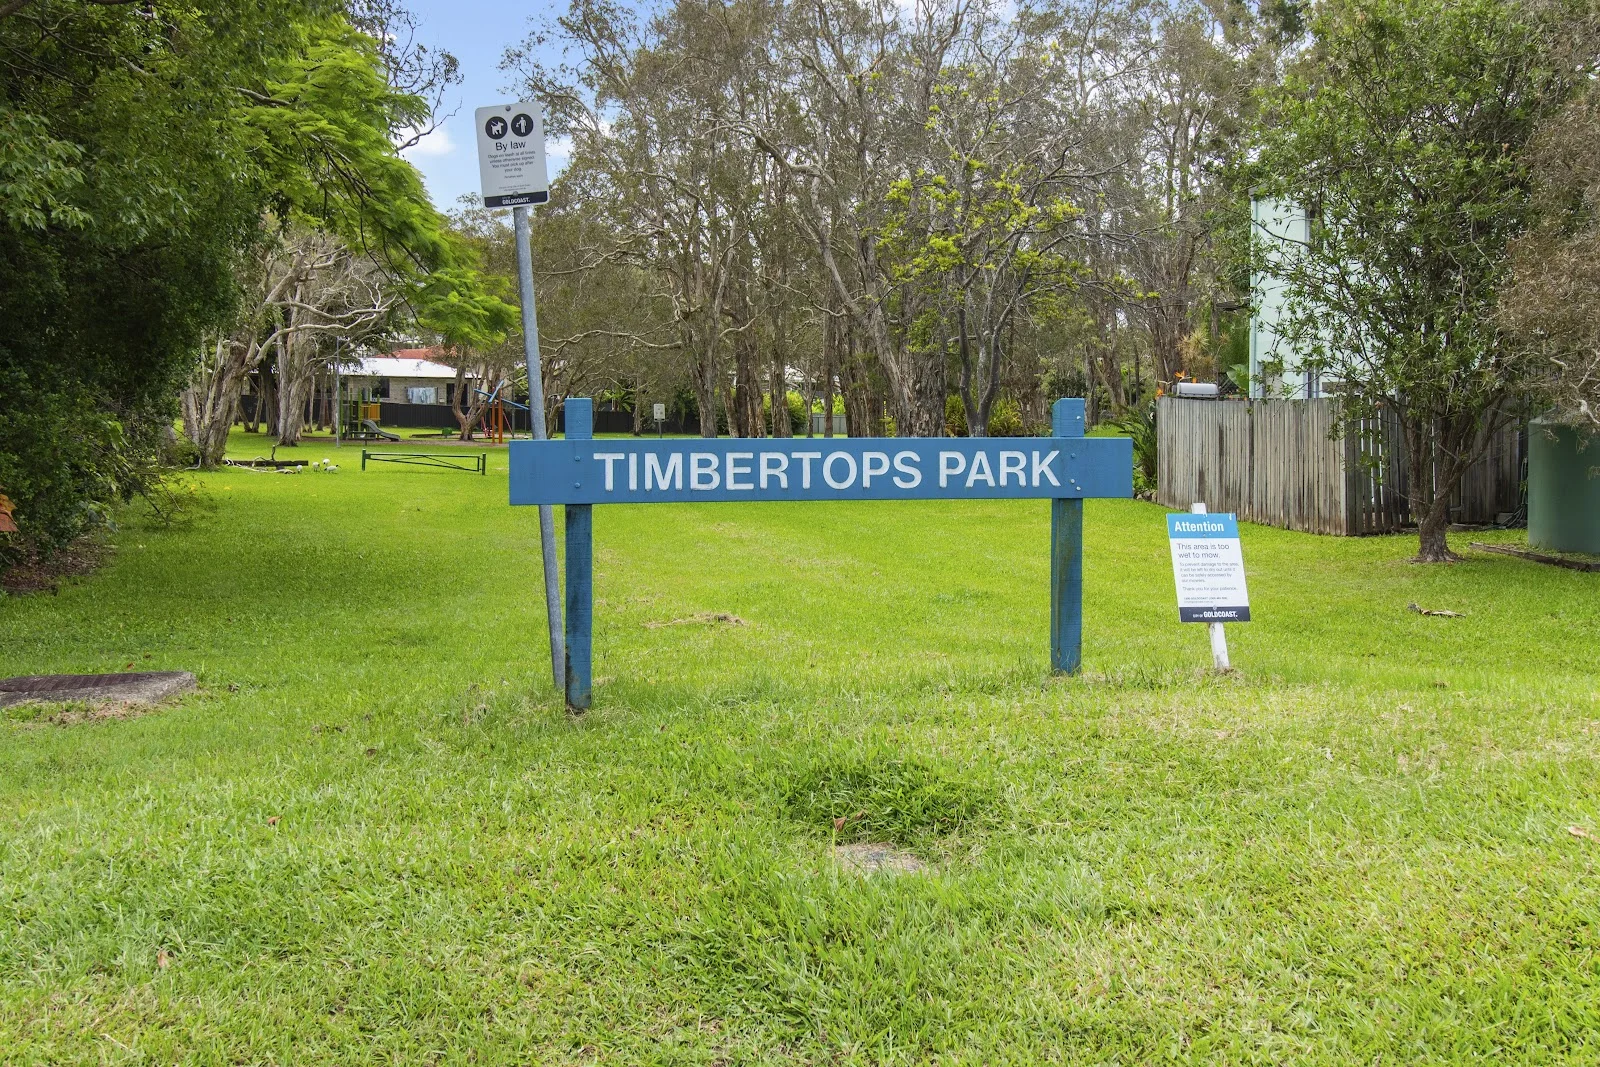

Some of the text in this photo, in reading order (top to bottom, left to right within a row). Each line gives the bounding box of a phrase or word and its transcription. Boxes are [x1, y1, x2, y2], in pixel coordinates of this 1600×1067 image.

[496, 141, 526, 152] By law
[594, 450, 1061, 492] TIMBERTOPS PARK
[1174, 521, 1224, 532] Attention
